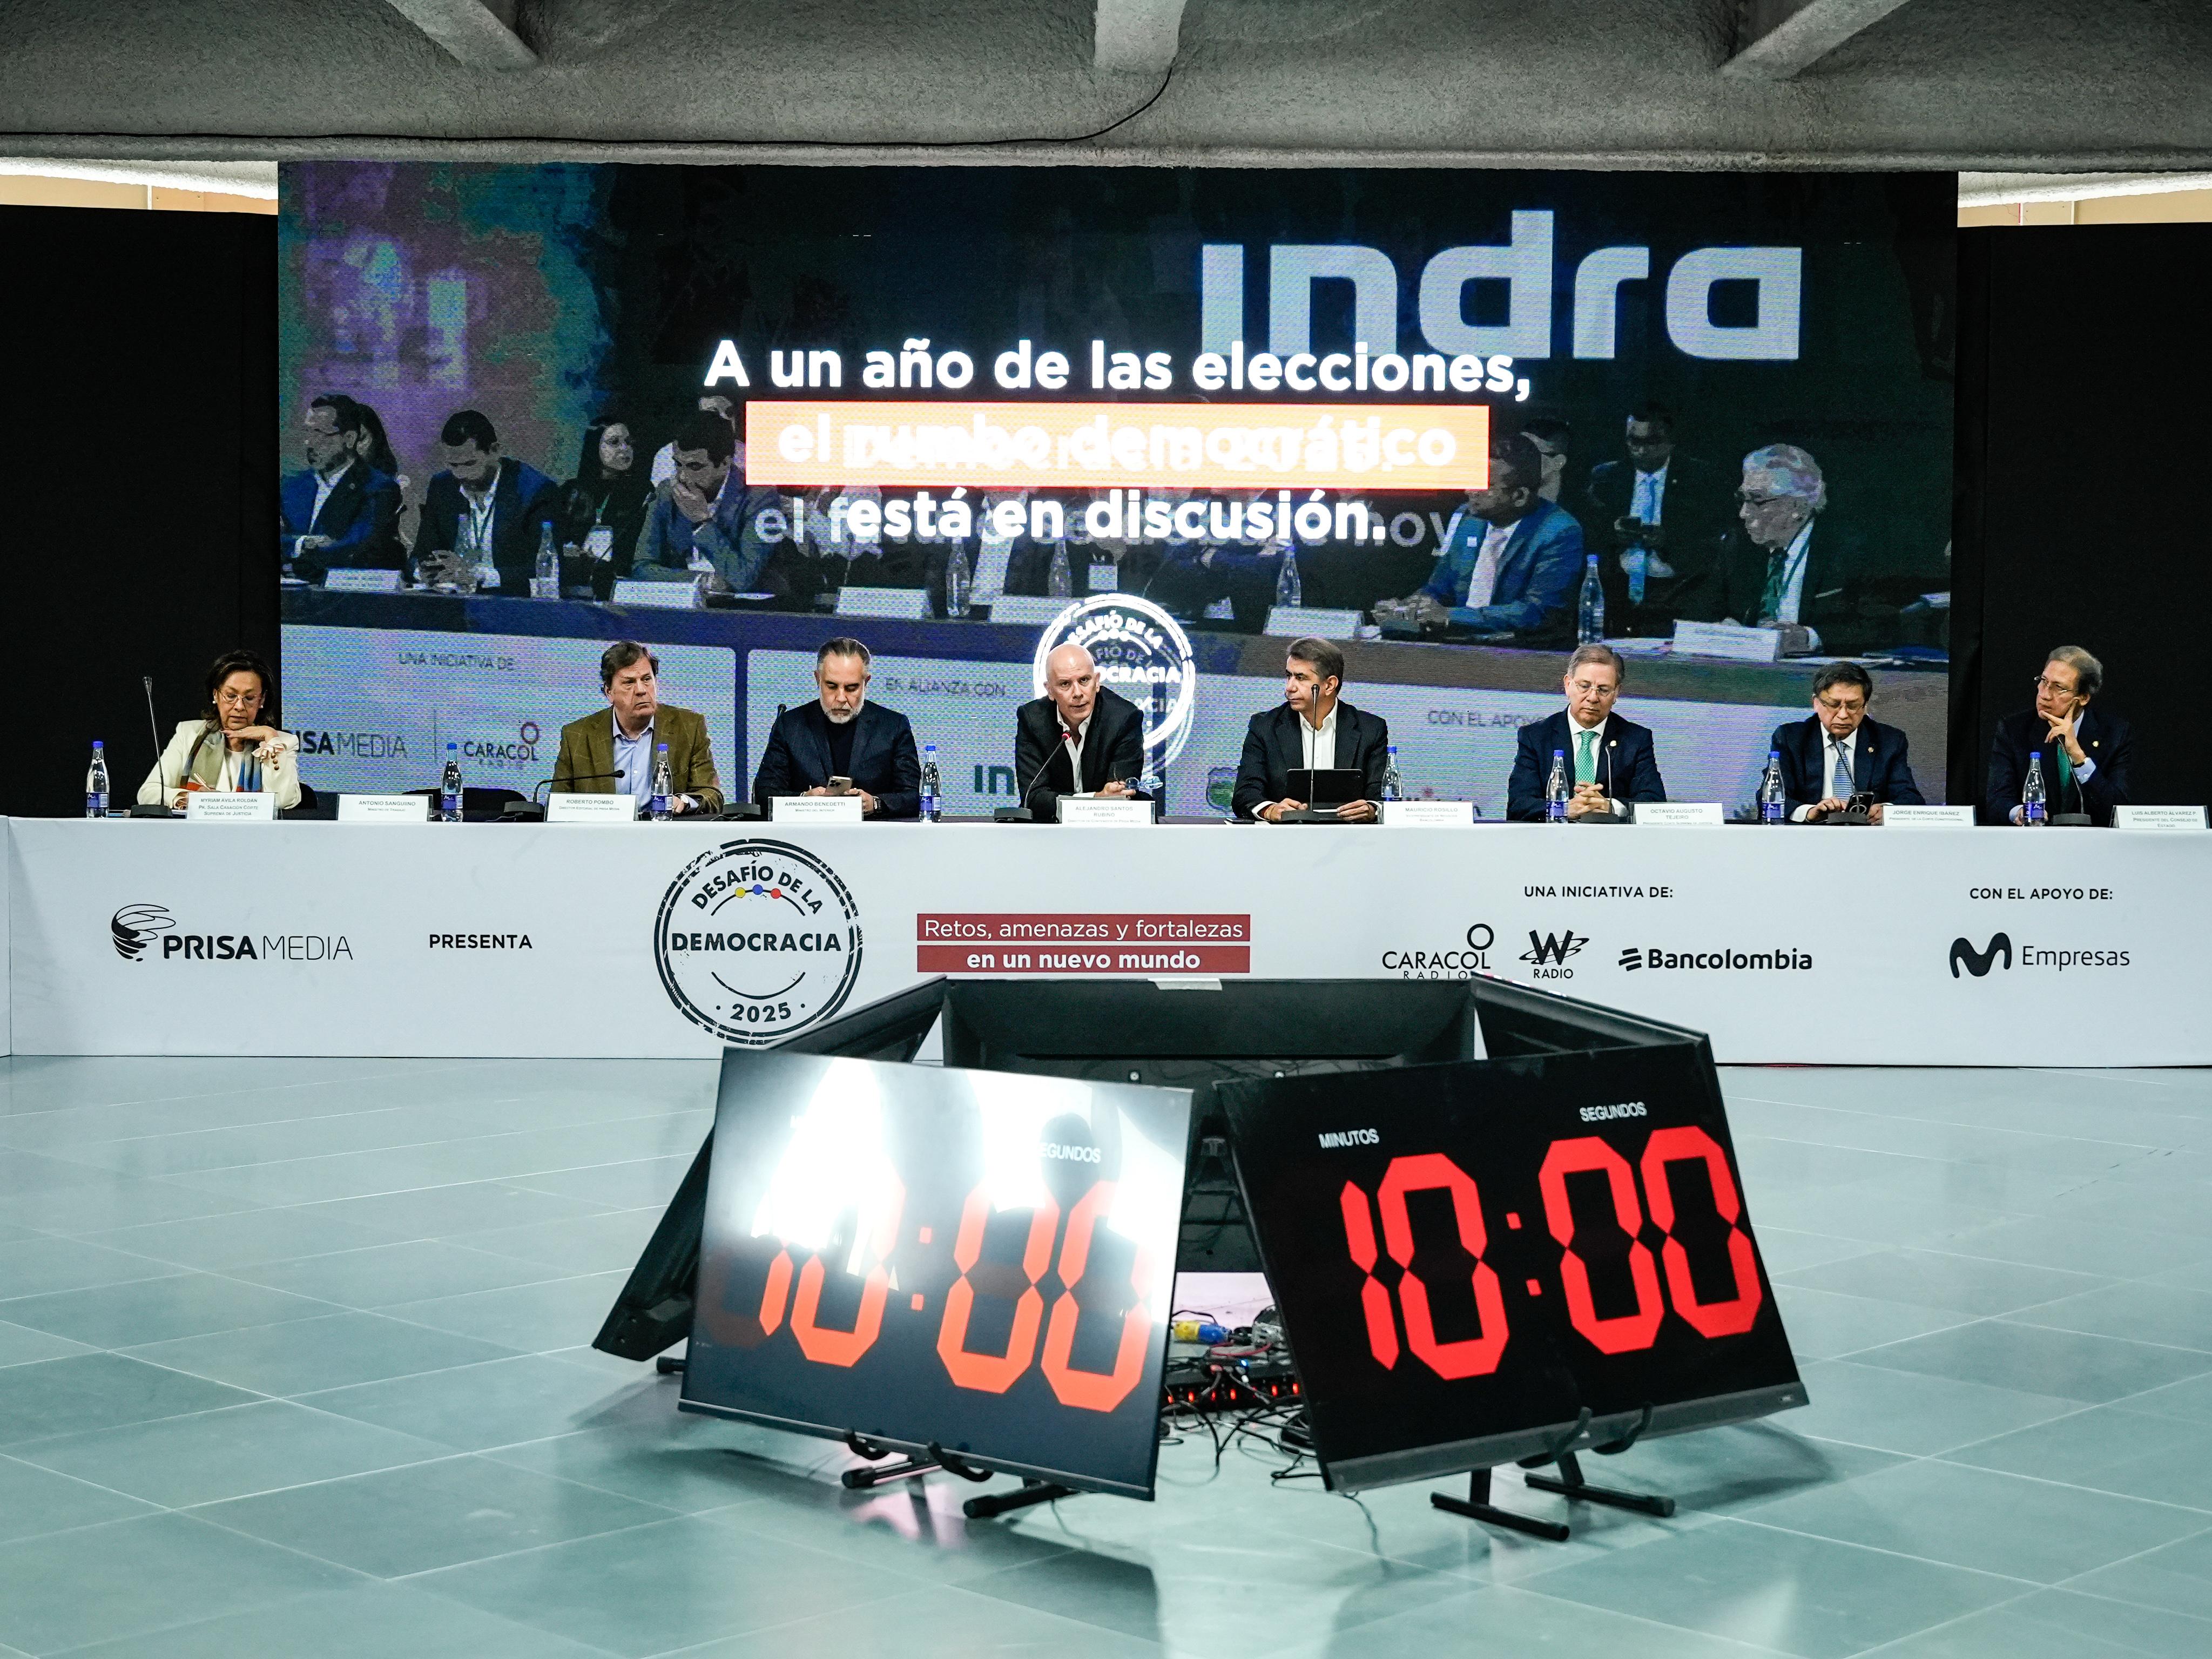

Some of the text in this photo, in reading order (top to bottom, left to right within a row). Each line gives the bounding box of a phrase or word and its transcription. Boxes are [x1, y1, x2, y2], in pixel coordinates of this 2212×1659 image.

[1202, 210, 1803, 360] indra
[704, 338, 1530, 402] A un año de las elecciones,
[779, 413, 831, 463] el
[846, 487, 1386, 540] está en discusión.
[1095, 665, 1181, 683] OCRACIA
[463, 741, 539, 761] CARACOL
[691, 860, 823, 915] DESAFÍO DE LA
[1524, 886, 1673, 899] UNA INICIATIVA DE:
[1970, 888, 2113, 900] CON EL APOYO DE:
[925, 920, 1243, 940] Retos, amenazas y fortalezas
[163, 935, 353, 960] PRISA MEDIA
[429, 934, 532, 949] PRESENTA
[671, 933, 841, 952] DEMOCRACIA
[967, 950, 1202, 969] en un nuevo mundo
[1382, 951, 1491, 970] CARACOL
[1648, 948, 1812, 970] Bancolombia
[2022, 946, 2130, 972] Empresas
[1404, 971, 1468, 980] RADIO
[1533, 969, 1574, 979] RADIO
[730, 1002, 792, 1023] 2025
[1579, 1101, 1648, 1123] SEGUNDOS
[1318, 1127, 1380, 1149] MINUTOS
[1038, 1142, 1102, 1163] EGUNDOS
[1340, 1125, 1763, 1381] 10:00
